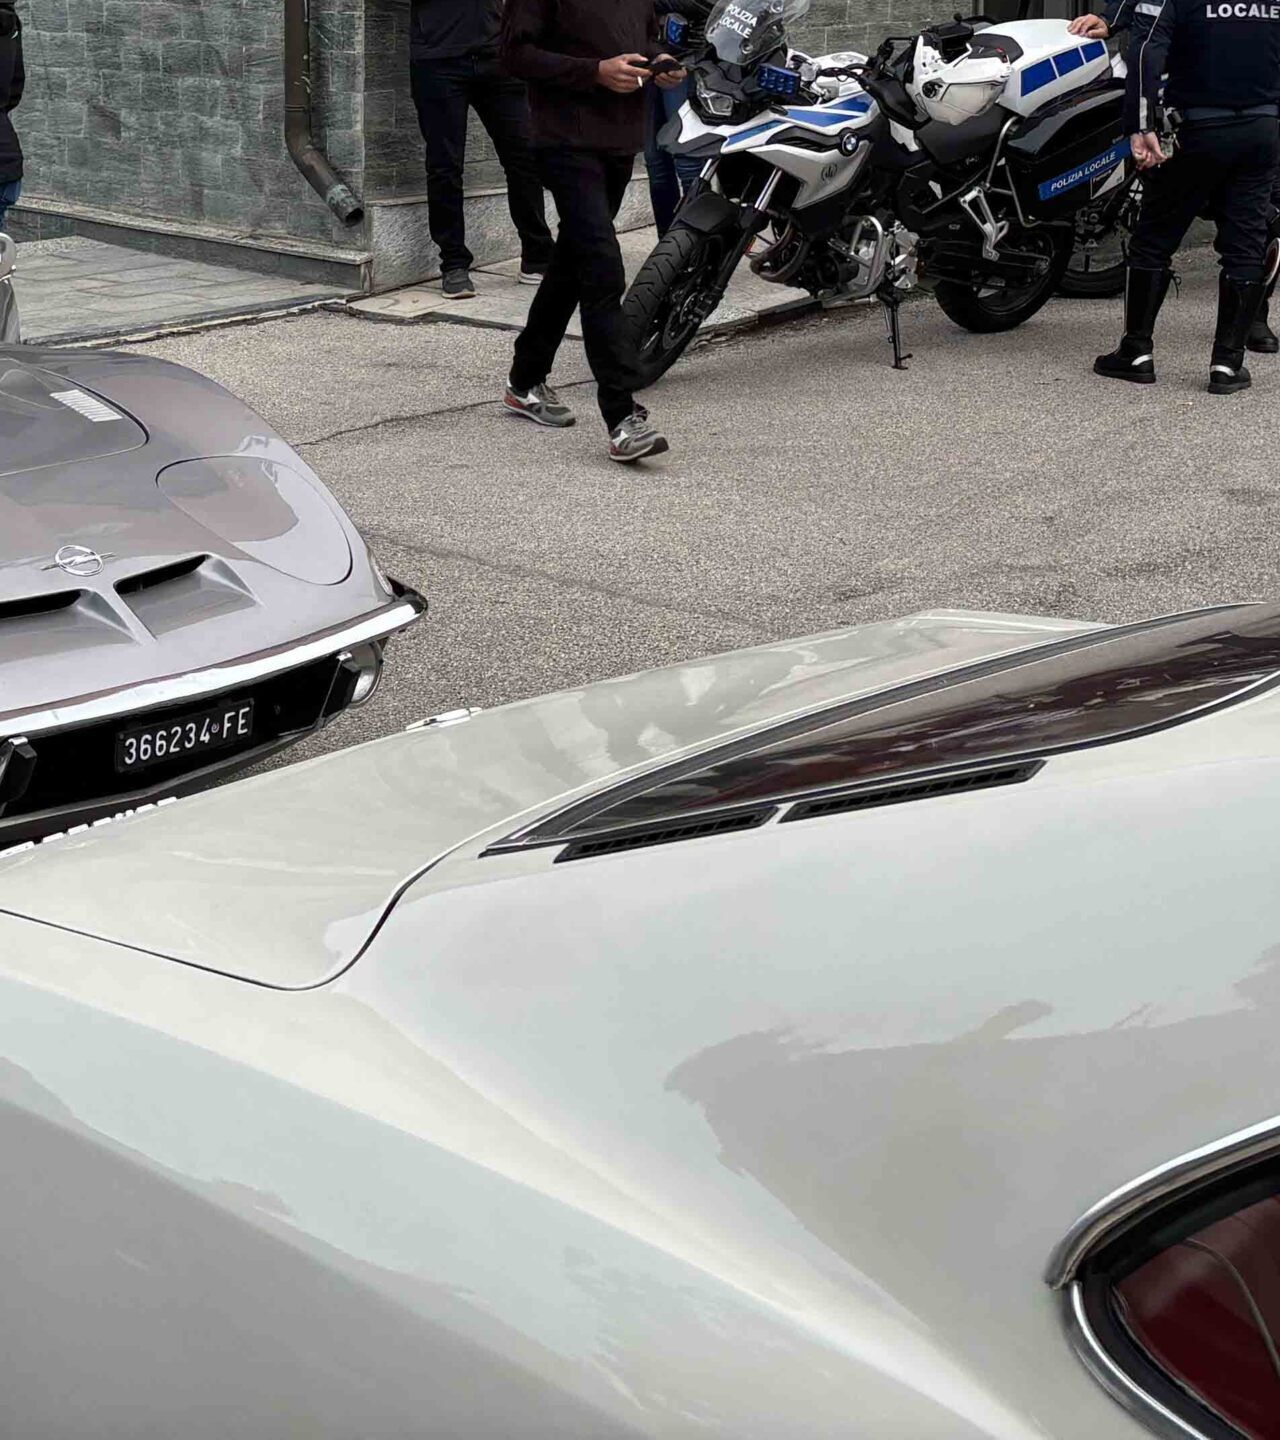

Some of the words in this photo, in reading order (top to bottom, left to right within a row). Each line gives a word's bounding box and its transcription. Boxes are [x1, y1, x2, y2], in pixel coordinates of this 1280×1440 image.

[724, 3, 758, 27] POLIZIA
[1206, 3, 1280, 19] LOCALE
[719, 15, 752, 38] LOCALE
[1051, 170, 1083, 191] POLIZIA
[1084, 151, 1116, 175] LOCALE
[124, 718, 211, 765] 366234
[223, 707, 250, 738] FE
